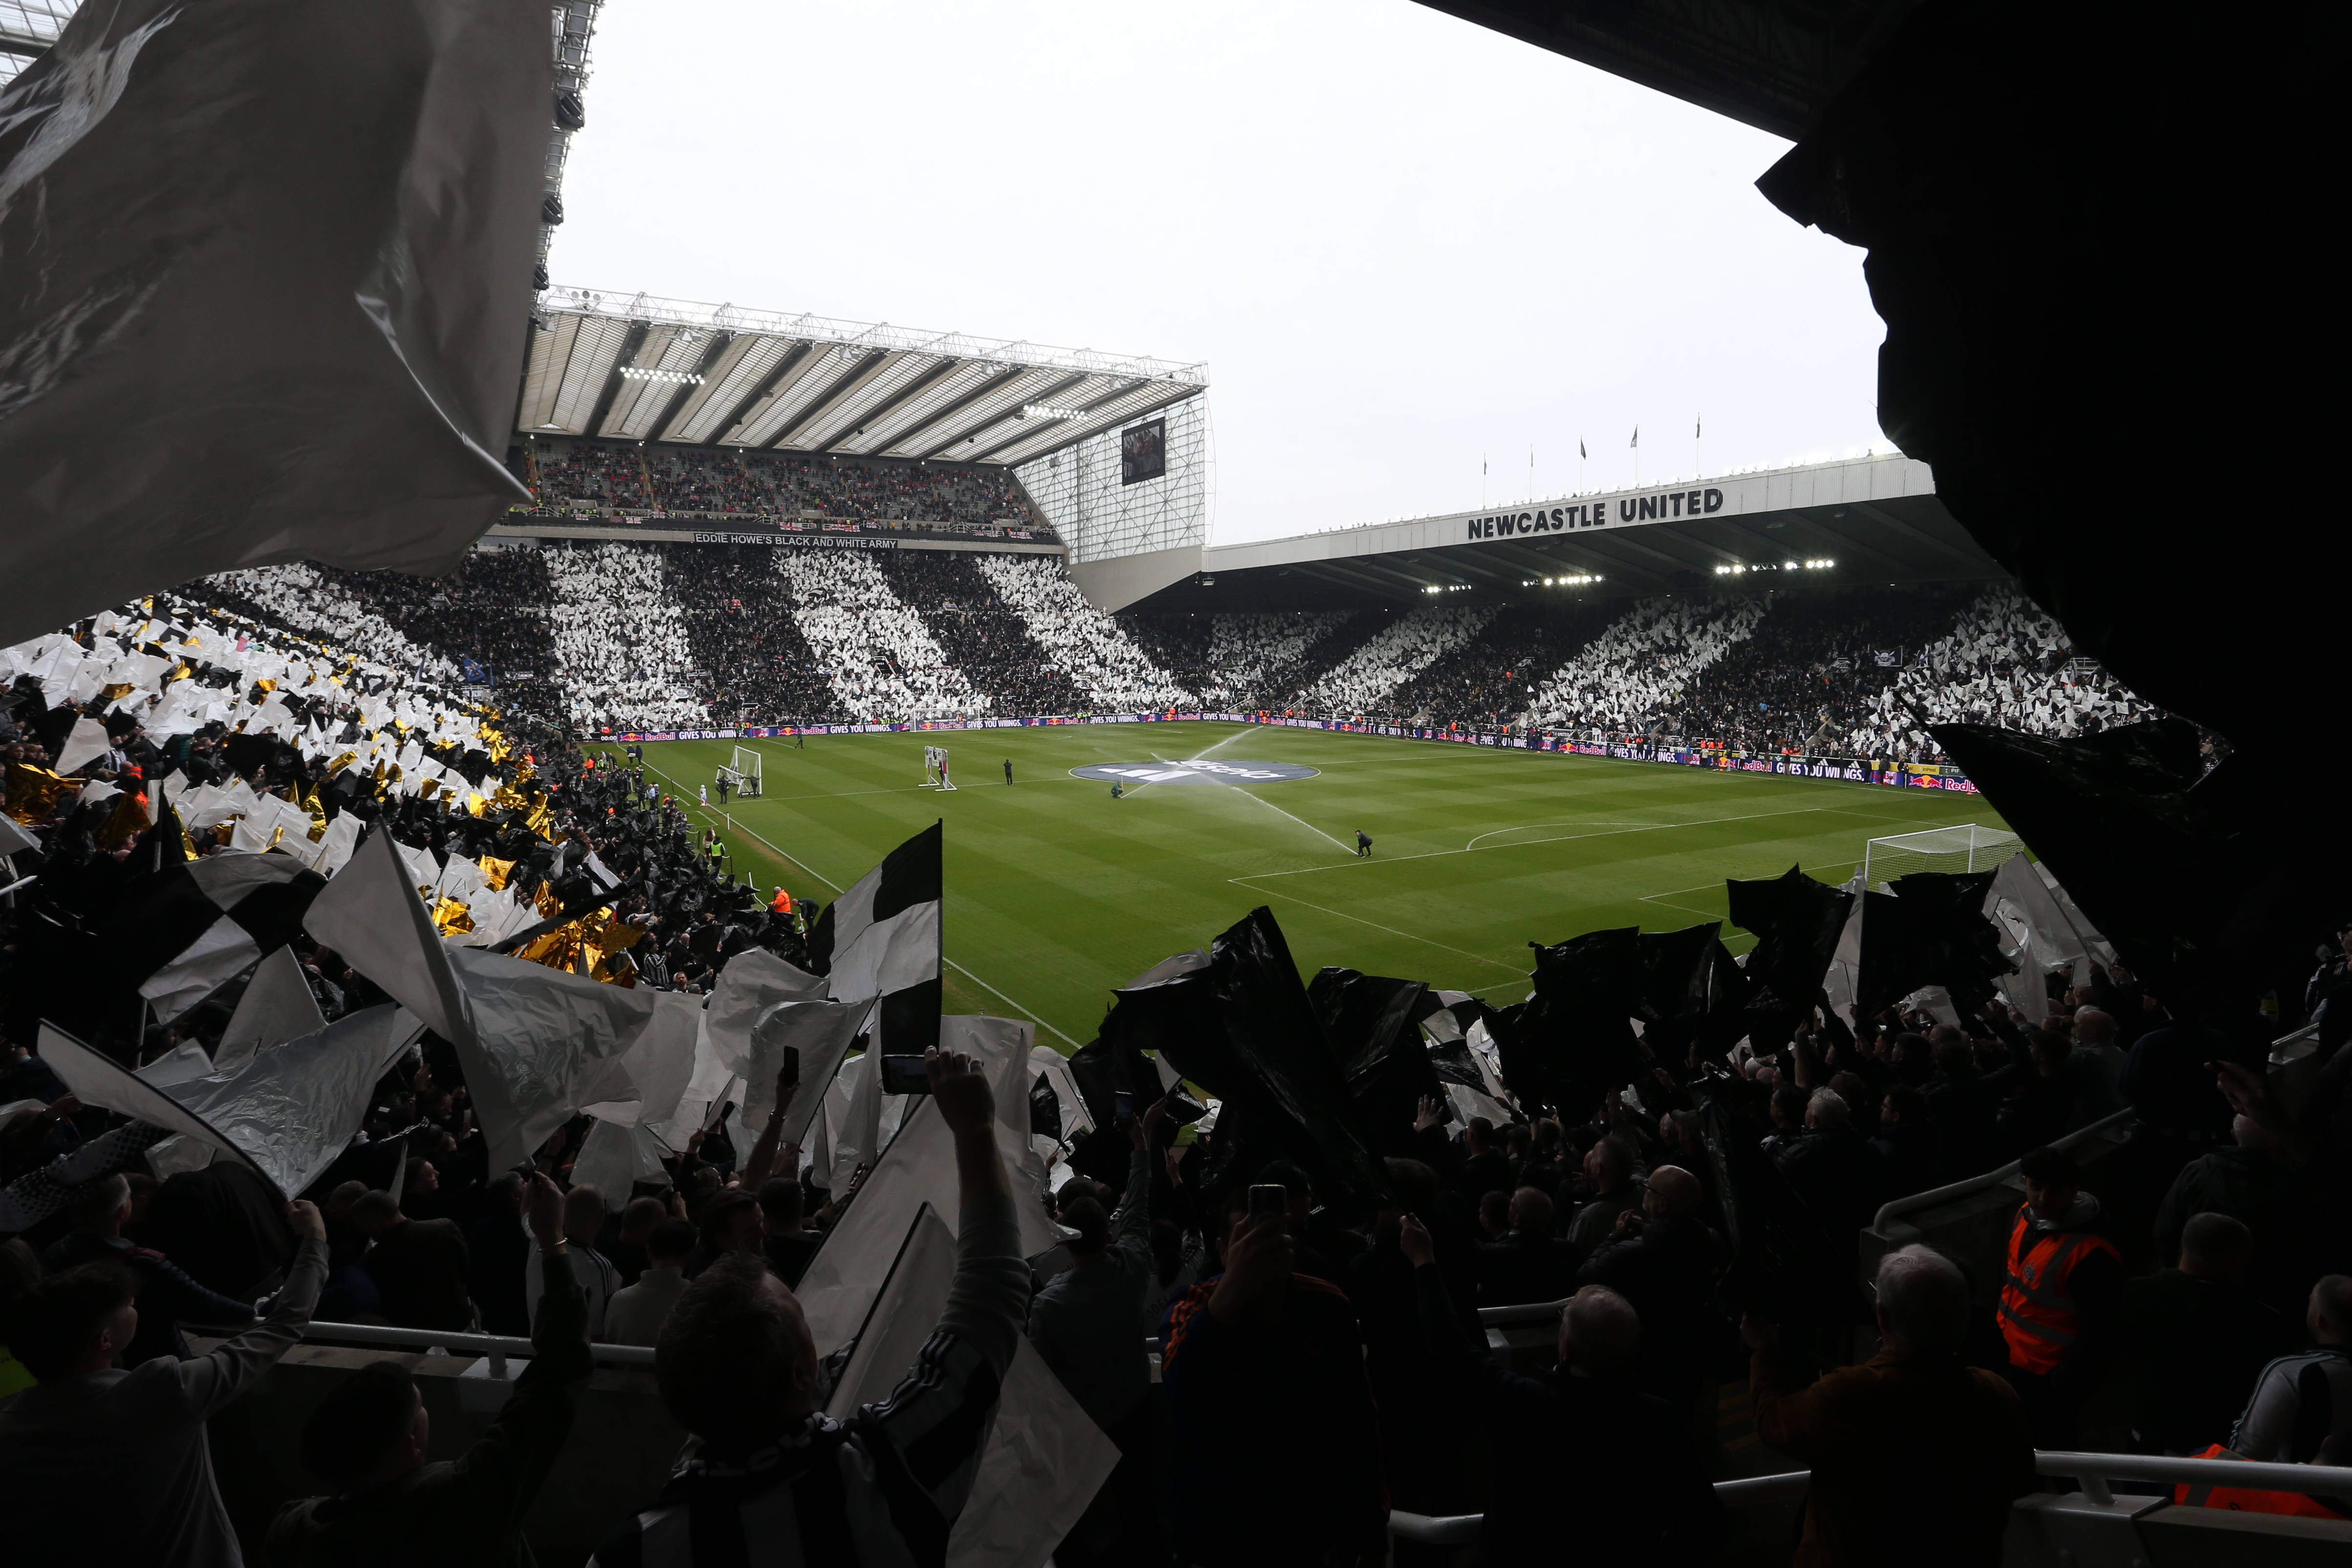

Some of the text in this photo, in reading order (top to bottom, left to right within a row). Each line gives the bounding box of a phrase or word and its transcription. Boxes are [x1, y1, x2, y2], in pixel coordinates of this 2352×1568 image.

[1468, 488, 1723, 539] NEWCASTLE UNITED
[696, 533, 896, 549] EDDIE HOWE'S BLACK AND WHITE ARMY
[967, 720, 983, 729] GIVES
[1298, 719, 1306, 727] YOU
[830, 725, 848, 734] GIVES
[679, 731, 699, 740] GIVES
[701, 731, 716, 739] YOU
